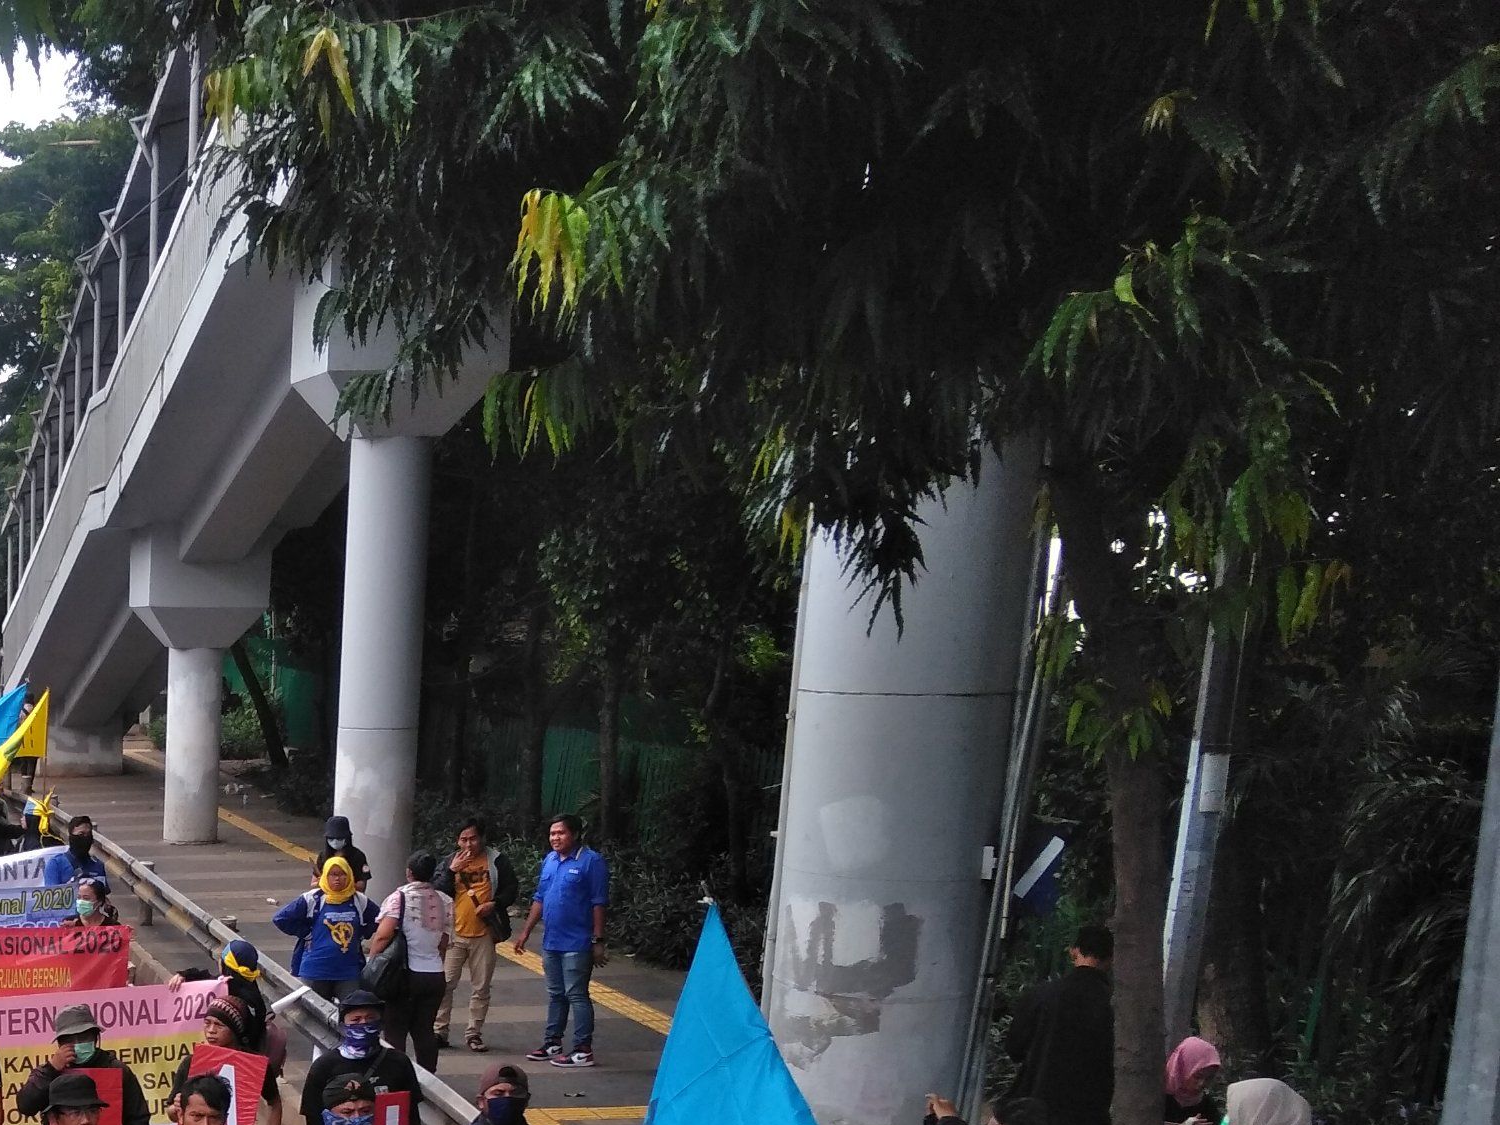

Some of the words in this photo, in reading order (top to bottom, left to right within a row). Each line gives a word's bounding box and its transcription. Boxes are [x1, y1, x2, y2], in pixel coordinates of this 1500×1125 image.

[32, 887, 74, 912] 2020
[73, 930, 123, 955] 2020
[32, 967, 72, 988] BERSAMA
